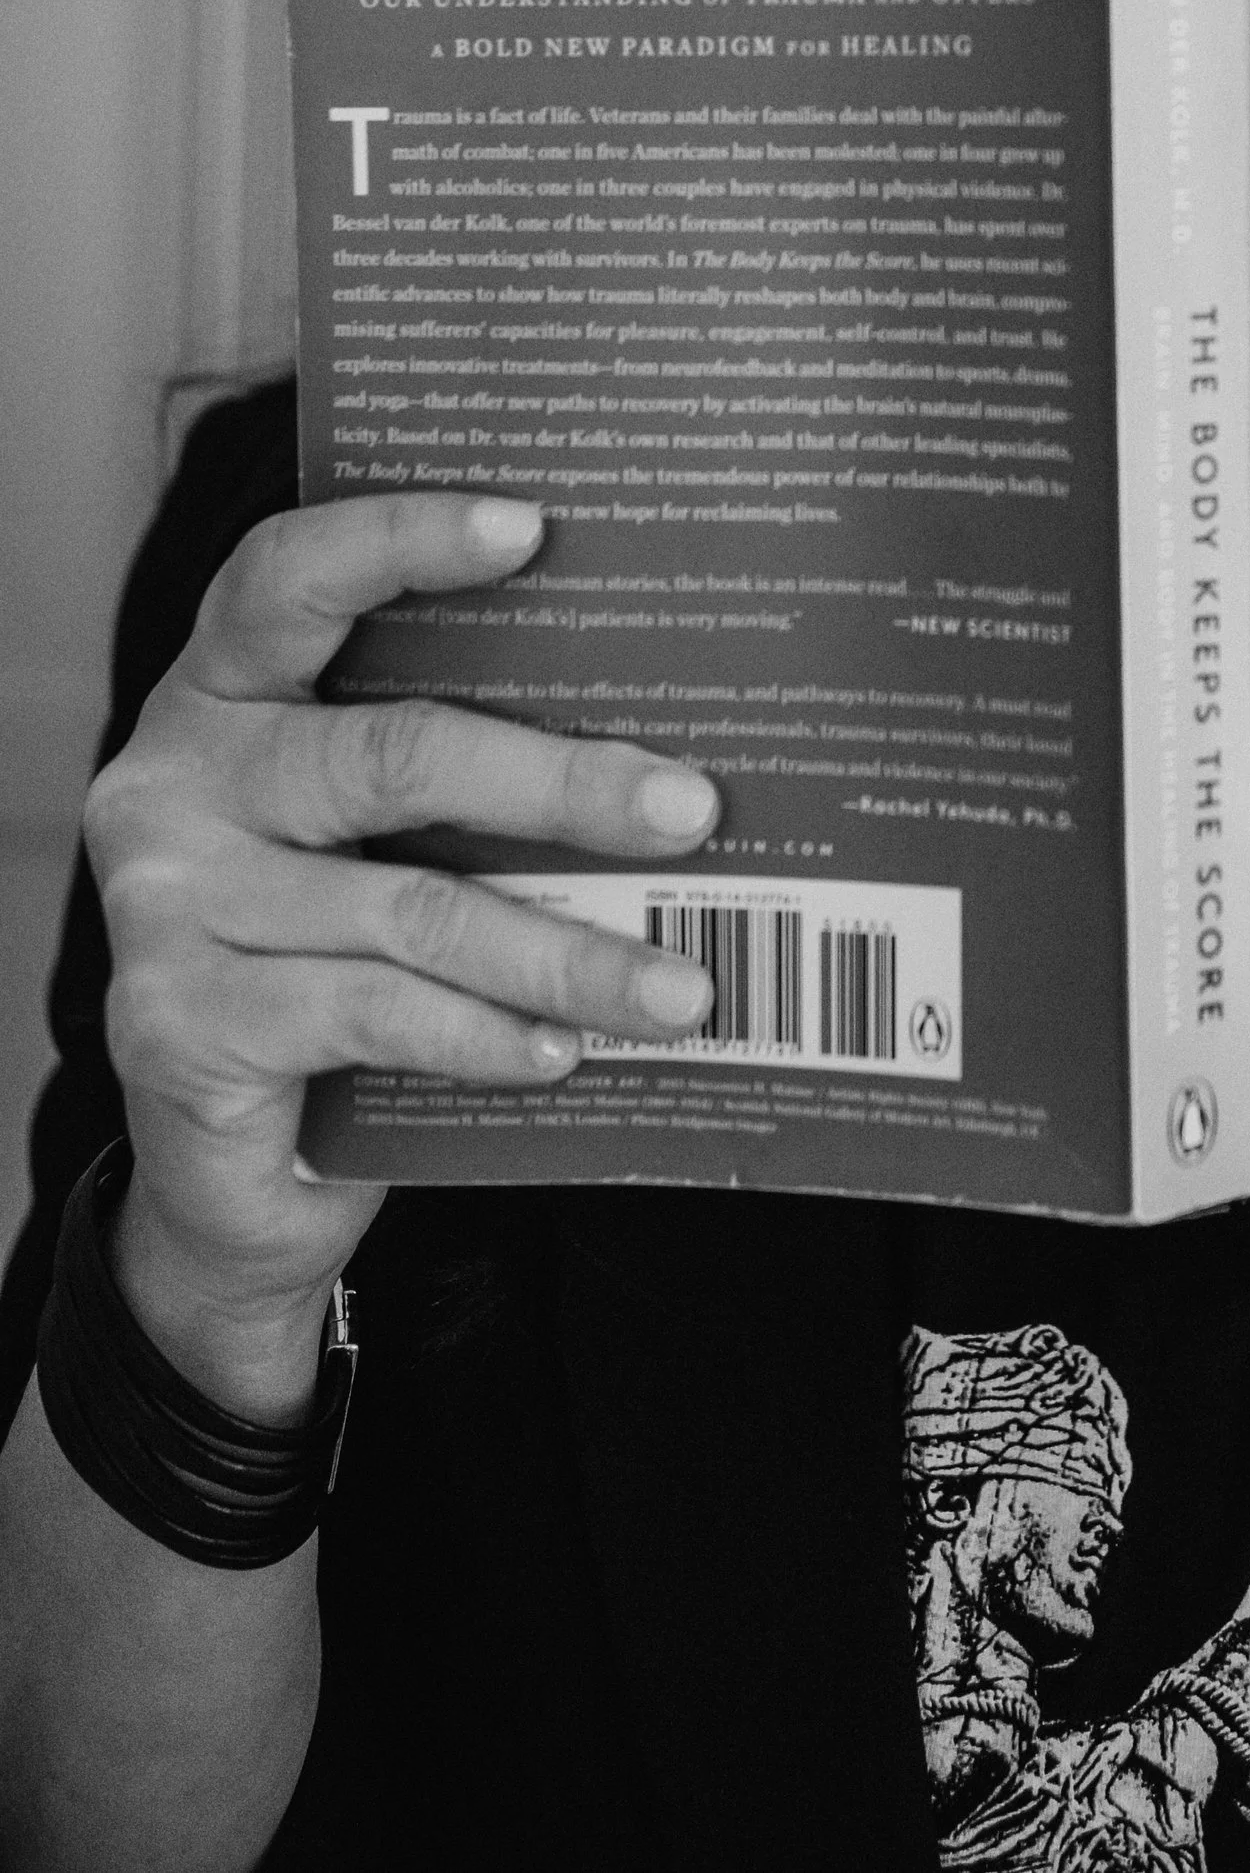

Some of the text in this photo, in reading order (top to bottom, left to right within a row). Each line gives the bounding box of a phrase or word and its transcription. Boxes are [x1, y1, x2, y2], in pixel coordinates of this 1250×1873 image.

[431, 35, 971, 57] A BOLD NEW PARADIGM FOR HEALING
[456, 106, 471, 125] is
[475, 110, 485, 125] a
[490, 106, 523, 126] fact
[528, 107, 546, 126] of
[550, 107, 584, 126] life.
[393, 141, 438, 160] math
[443, 141, 460, 160] of
[464, 141, 537, 163] combat;
[539, 146, 570, 161] one
[390, 177, 431, 196] with
[437, 177, 536, 199] alcoholics;
[538, 182, 571, 197] one
[333, 213, 571, 235] Bessel van der Kolk, one of
[333, 248, 571, 273] three decades working with
[333, 283, 542, 305] entific advances to show
[334, 320, 581, 344] mising sufferers’ capacities
[333, 355, 658, 379] explores innovative treatments—from
[334, 391, 542, 415] and yoga—that offer new
[334, 426, 531, 450] ticity. Based on Dr. van
[334, 461, 544, 487] The Body Keeps the Score
[1190, 307, 1224, 1023] THE BODY KEEPS THE SCORE
